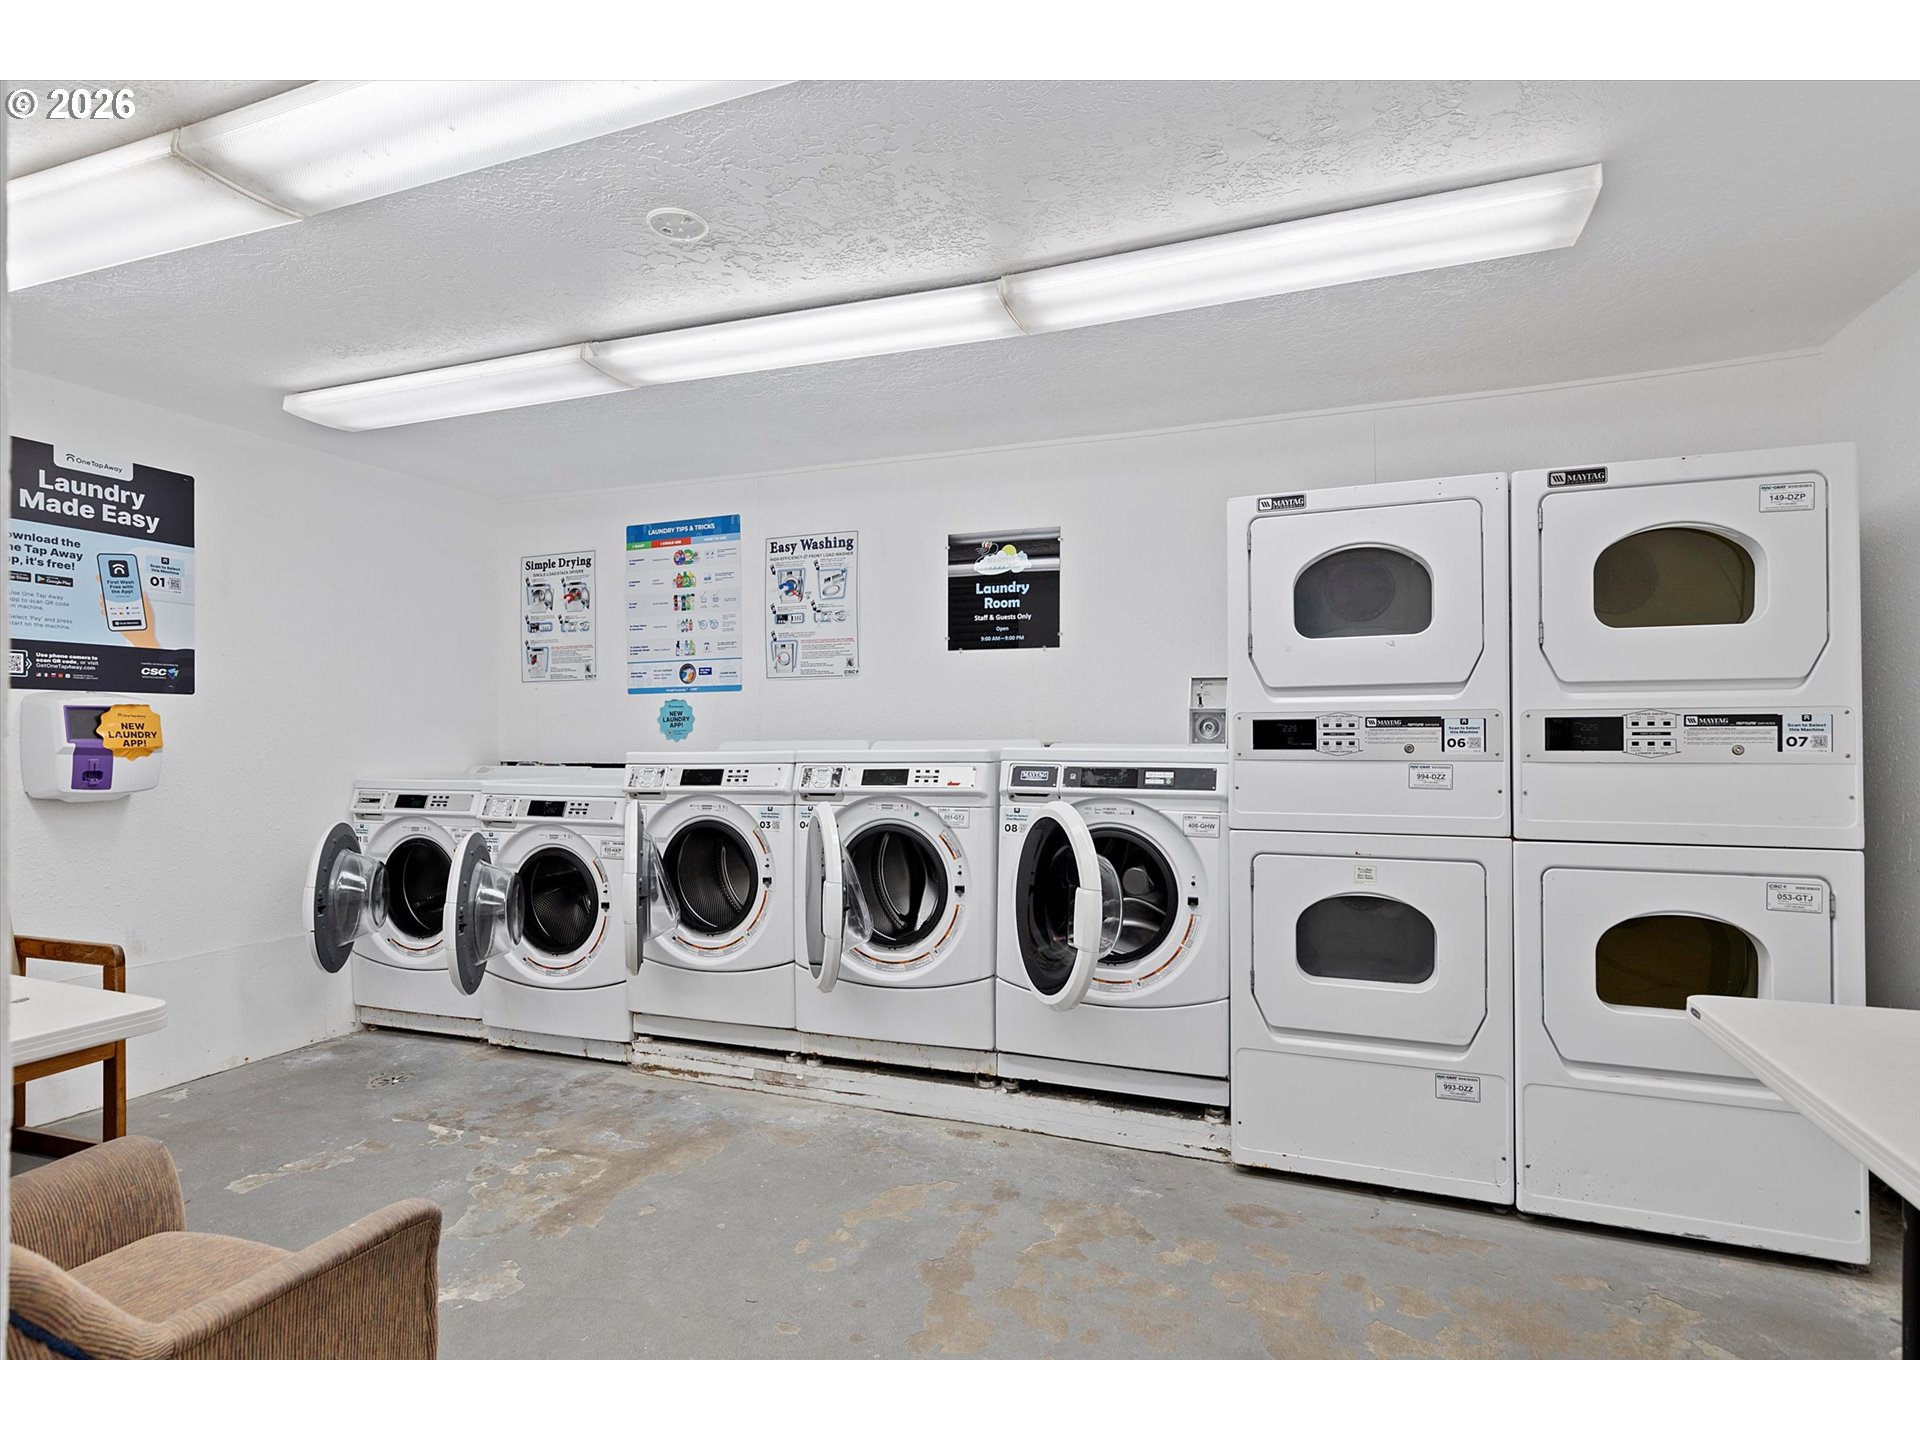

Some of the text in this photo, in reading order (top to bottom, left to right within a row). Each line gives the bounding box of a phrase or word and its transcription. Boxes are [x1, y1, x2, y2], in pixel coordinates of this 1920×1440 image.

[1567, 472, 1604, 481] MAYTAG
[38, 469, 146, 510] Laundry
[1273, 498, 1304, 506] MAYTAG
[20, 488, 160, 534] Made Easy
[648, 527, 675, 536] LAUNDRY
[61, 538, 81, 548] the
[770, 537, 854, 555] Easy Washing
[24, 544, 47, 556] Tap
[50, 548, 84, 562] Away
[26, 556, 44, 566] it's
[47, 560, 75, 570] free!
[525, 556, 592, 572] Simple Drying
[150, 576, 165, 587] 01
[975, 581, 1030, 594] Laundry
[984, 597, 1020, 609] Room
[141, 667, 167, 676] CSC
[1447, 738, 1466, 748] 06
[1786, 736, 1808, 747] 07
[1005, 824, 1017, 832] 08
[1777, 893, 1813, 902] 053-GTJ
[1444, 1084, 1474, 1092] 993-DZZ
